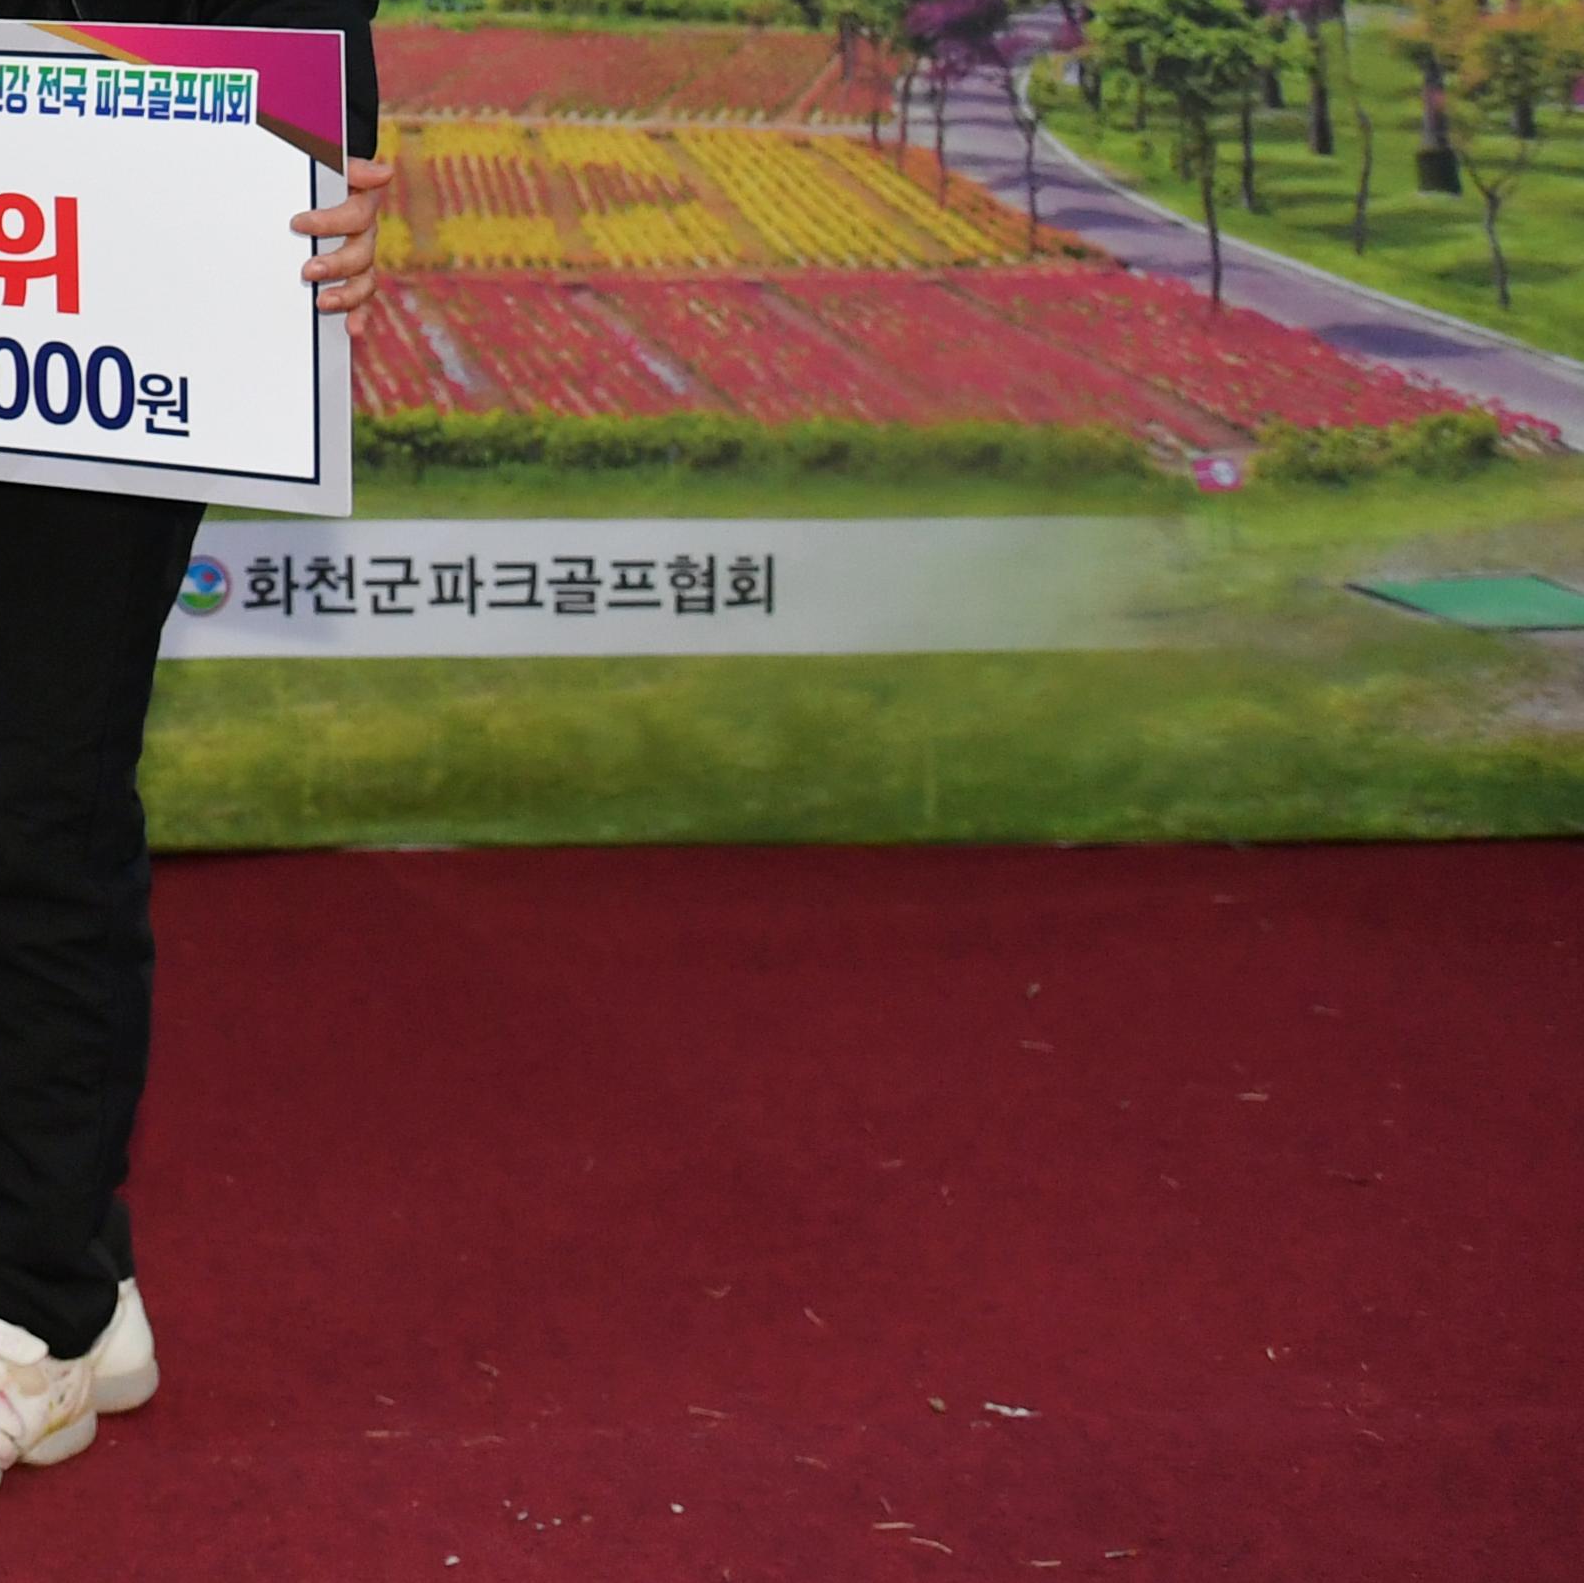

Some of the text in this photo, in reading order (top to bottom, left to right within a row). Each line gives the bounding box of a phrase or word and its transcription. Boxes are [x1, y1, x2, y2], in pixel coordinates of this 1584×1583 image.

[37, 66, 88, 117] 전국
[95, 68, 253, 125] 파크골프대회
[242, 554, 775, 617] 화천군파크골프협회
